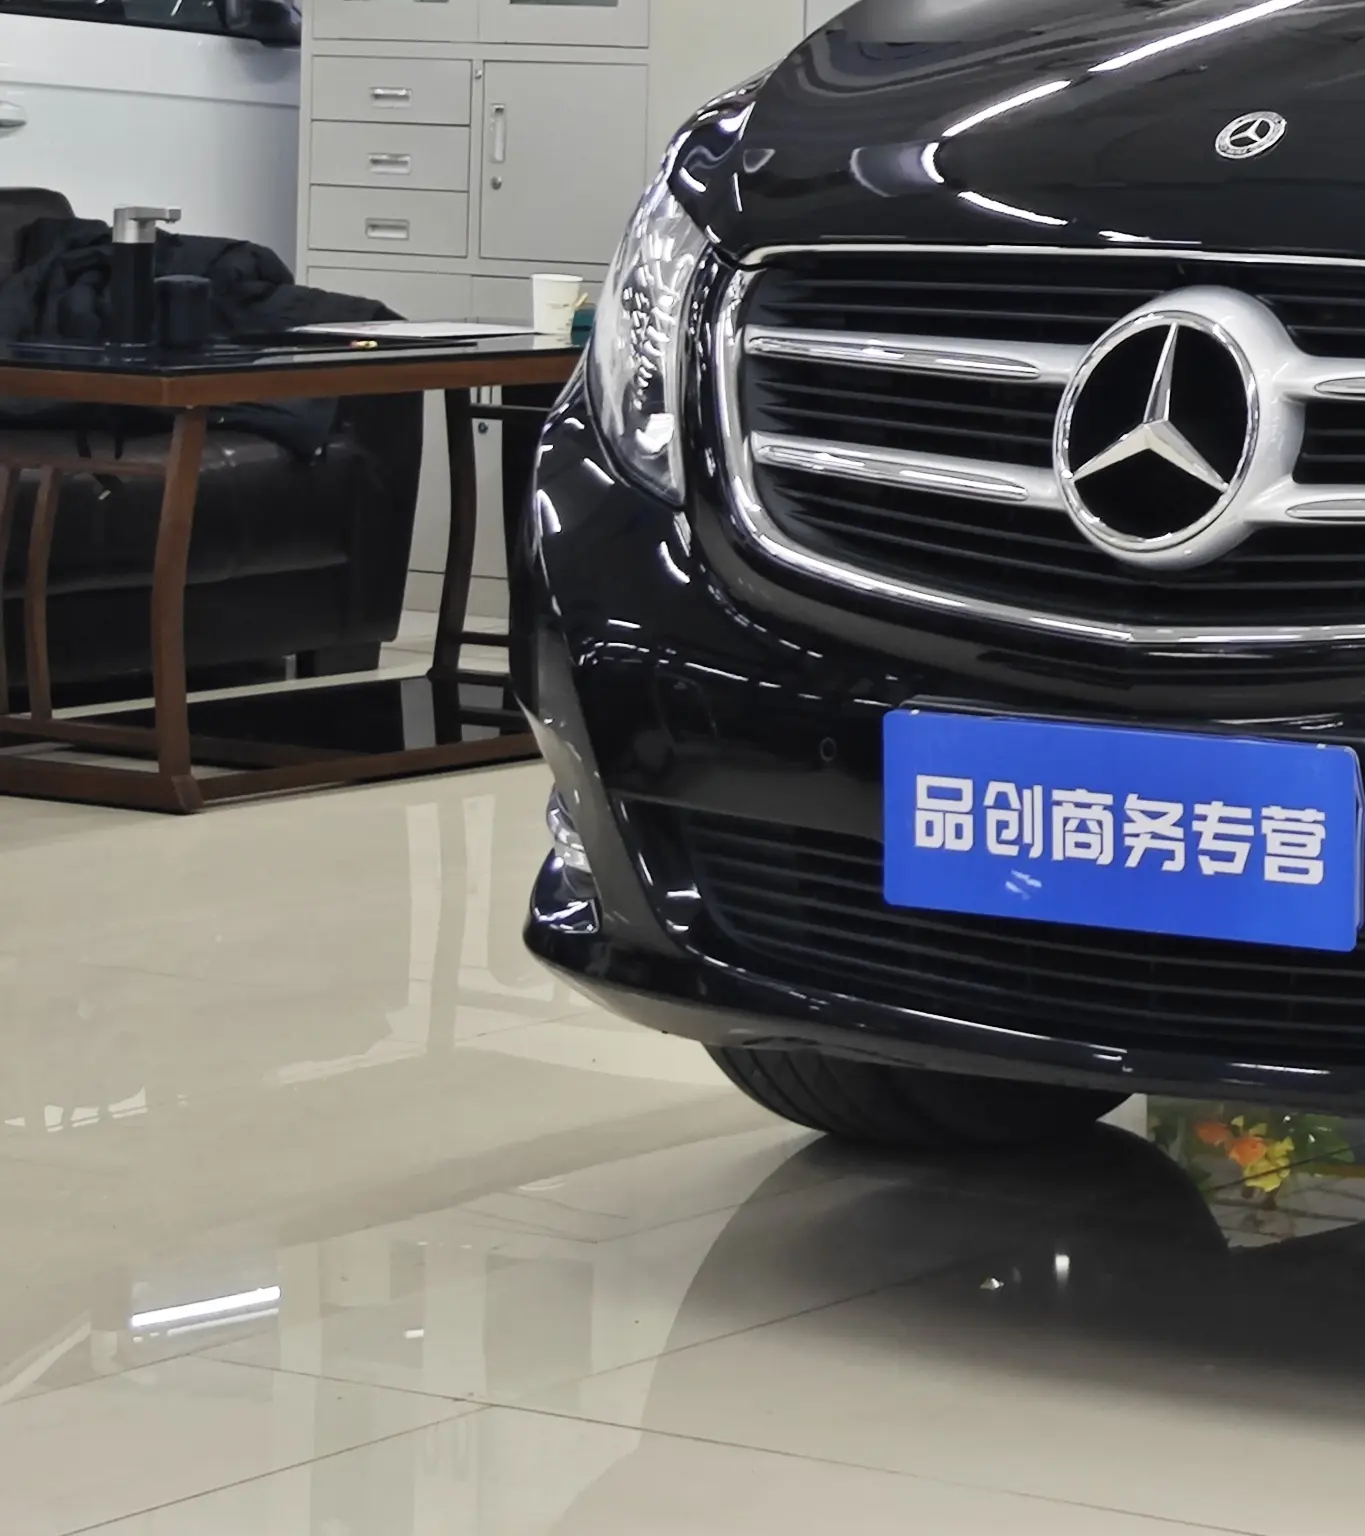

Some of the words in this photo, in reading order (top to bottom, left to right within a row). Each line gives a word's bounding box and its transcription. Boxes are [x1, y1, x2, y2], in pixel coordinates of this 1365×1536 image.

[914, 773, 1327, 886] 品创商务专营
